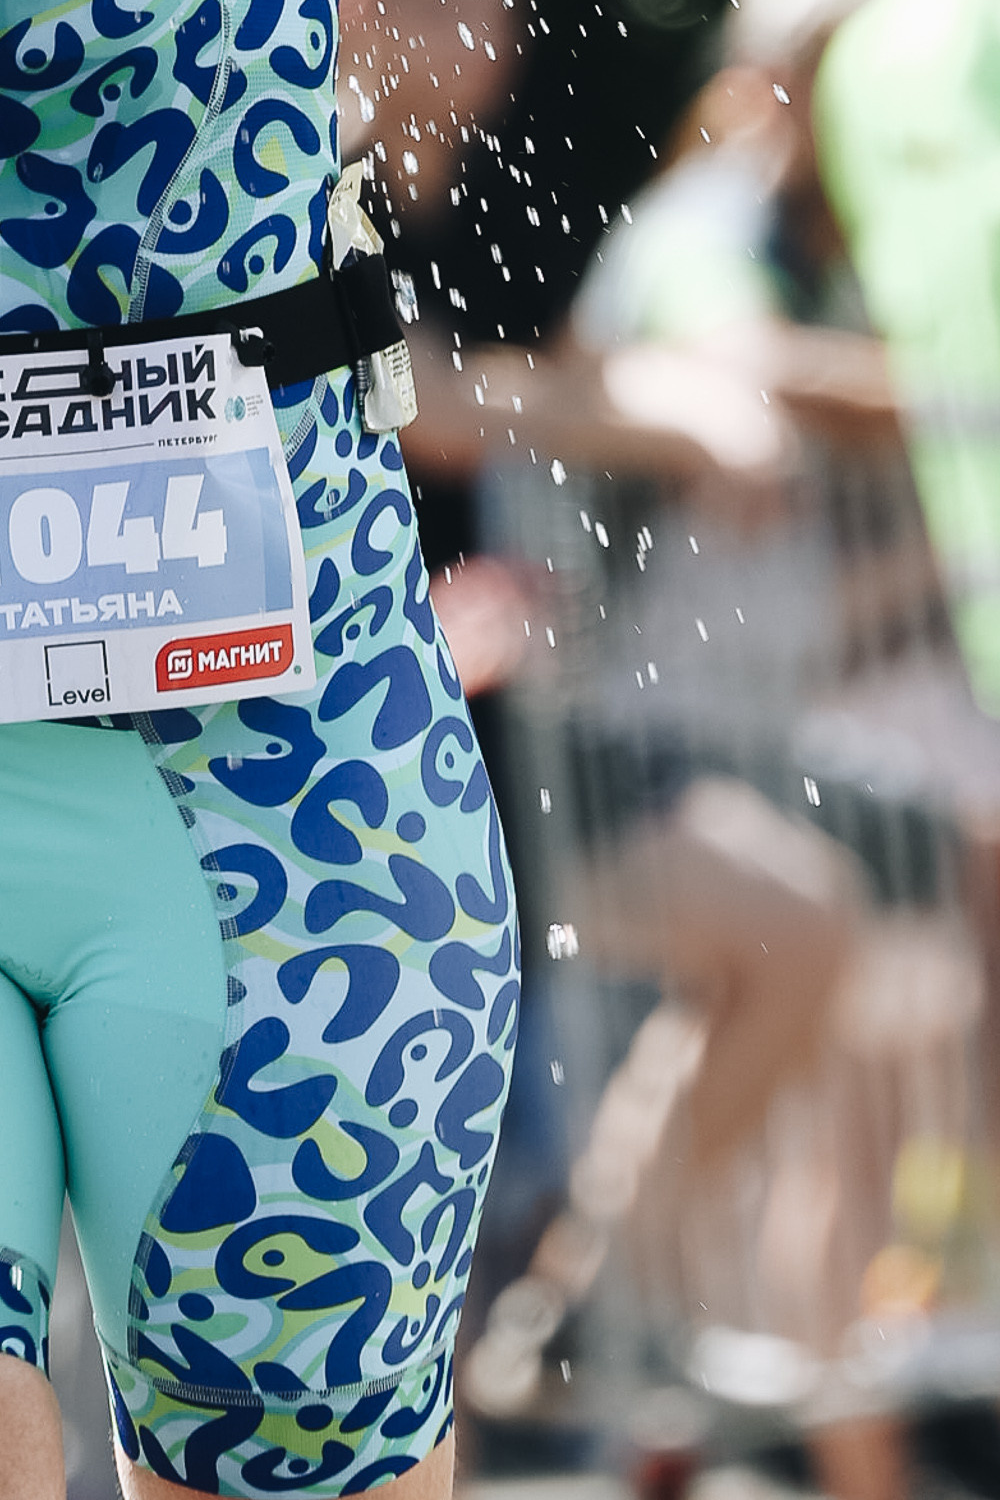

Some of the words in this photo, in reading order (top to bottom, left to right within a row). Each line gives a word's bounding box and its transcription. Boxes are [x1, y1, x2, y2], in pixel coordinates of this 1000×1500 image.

[158, 434, 218, 448] ПЕТЕРБУРГ
[198, 641, 283, 672] МАГНИТ
[48, 677, 111, 706] Level
